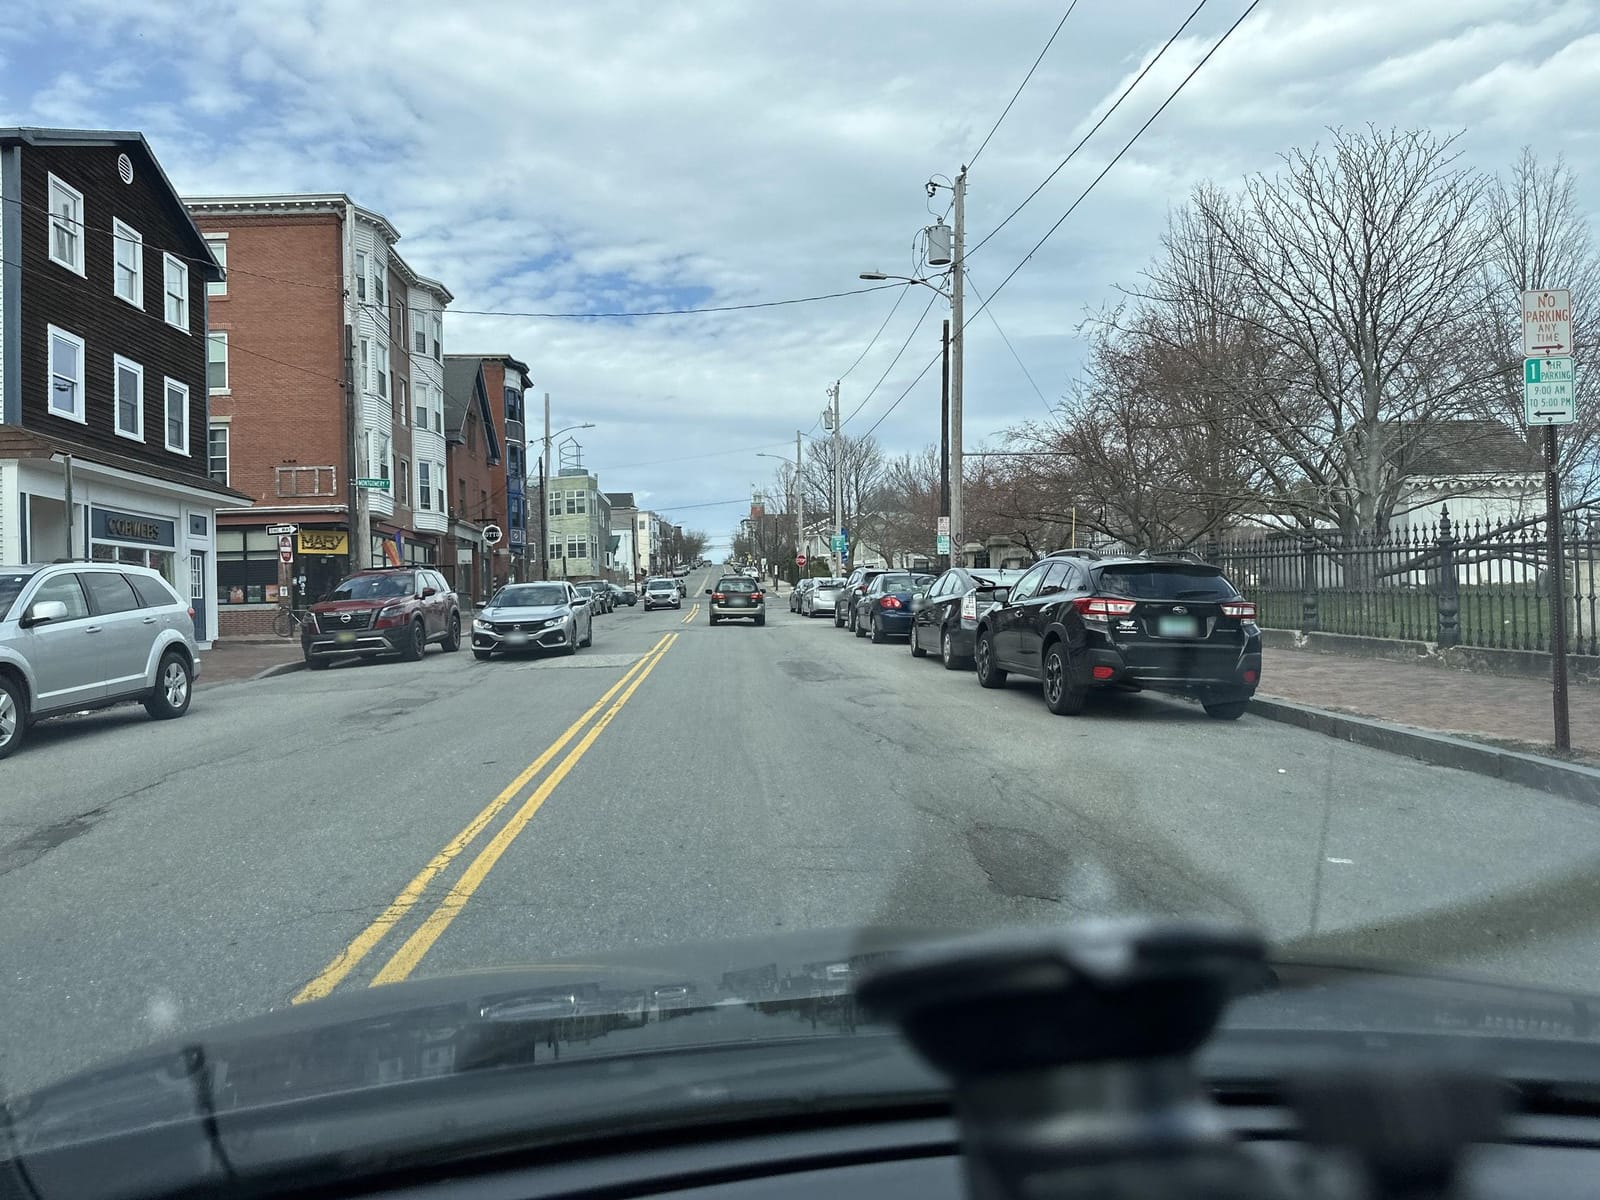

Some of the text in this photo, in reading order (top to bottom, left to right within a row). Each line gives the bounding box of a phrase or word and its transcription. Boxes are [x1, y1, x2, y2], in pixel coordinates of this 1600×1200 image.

[1538, 295, 1556, 308] NO
[1526, 309, 1568, 323] PARKING
[1538, 323, 1556, 332] ANY
[1536, 333, 1559, 342] TIME
[1530, 361, 1562, 380] 1 HR
[1541, 371, 1571, 380] PARKING
[1534, 386, 1566, 395] 9:00 AM
[1530, 397, 1571, 408] TO 5:00 PM
[301, 534, 345, 550] MARY
